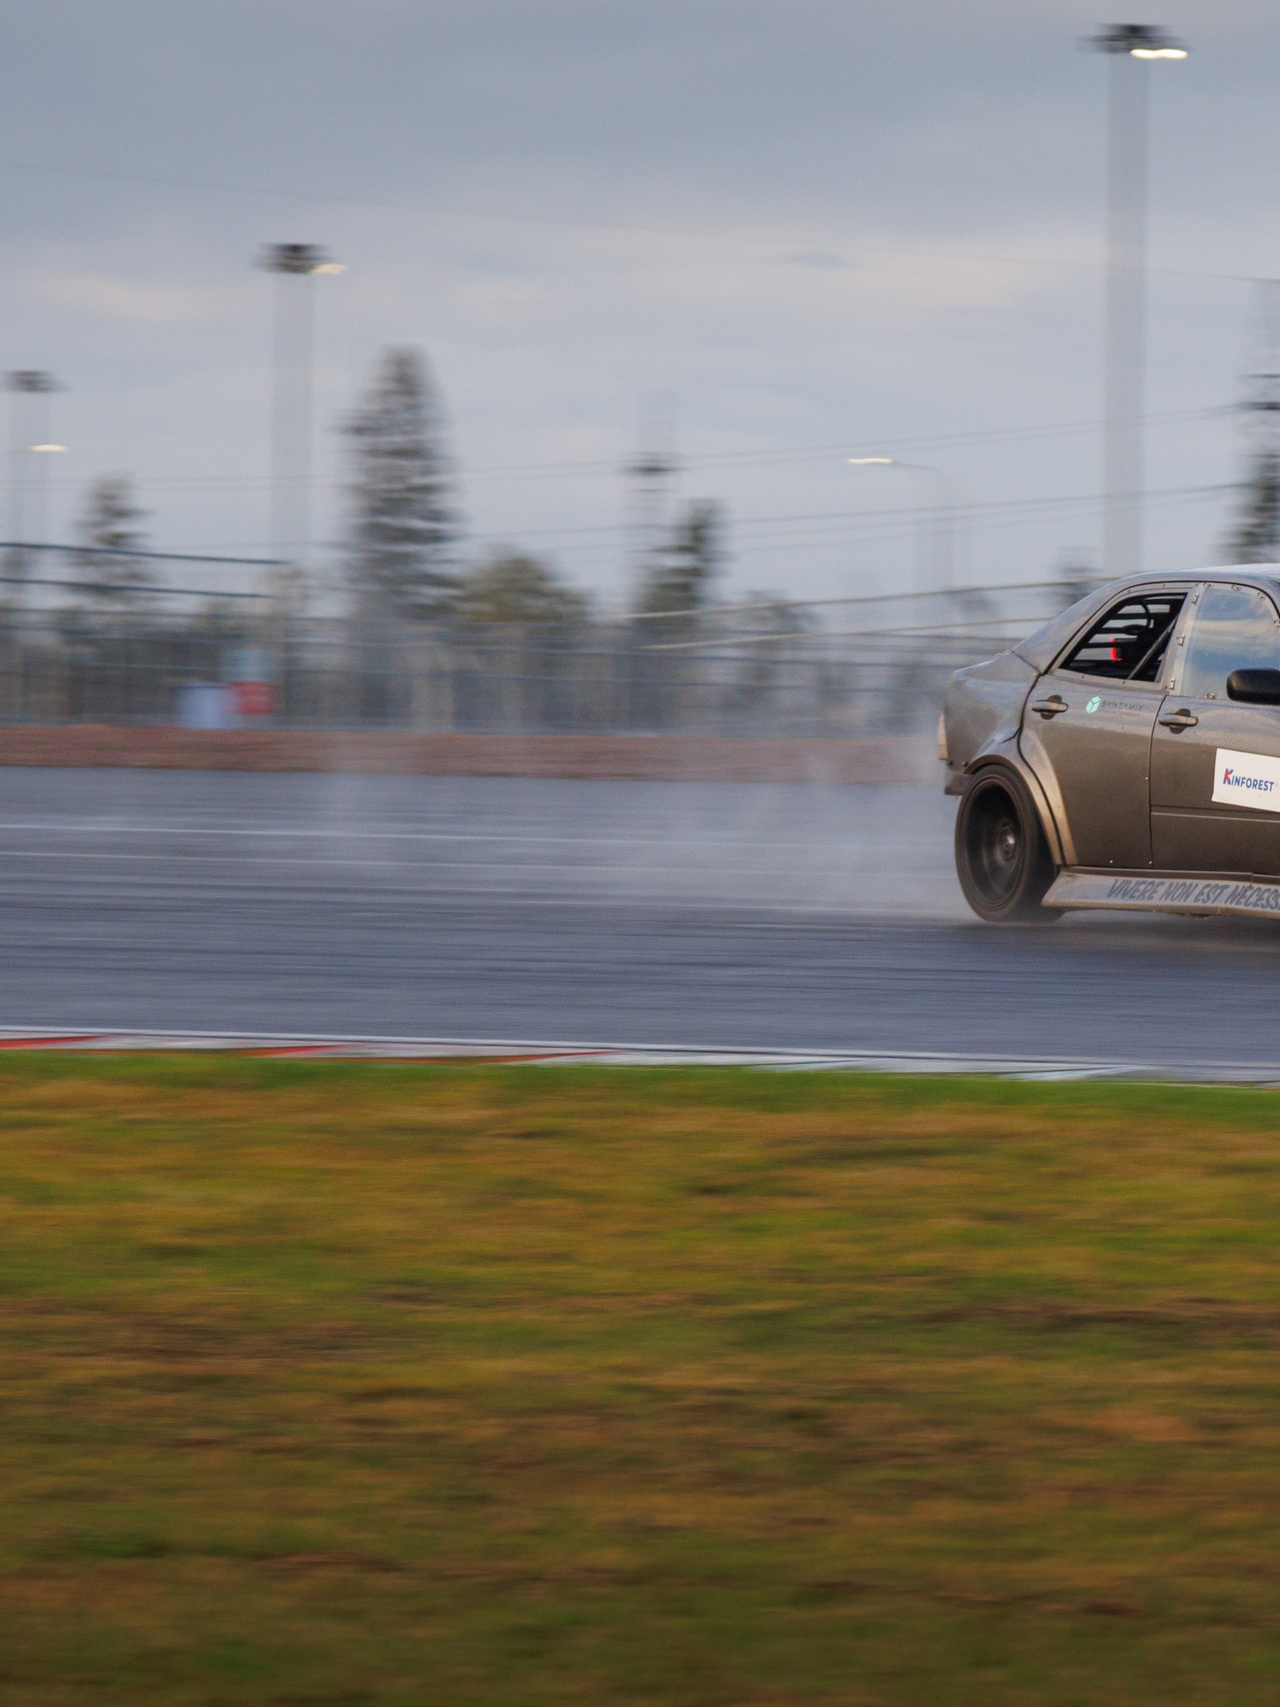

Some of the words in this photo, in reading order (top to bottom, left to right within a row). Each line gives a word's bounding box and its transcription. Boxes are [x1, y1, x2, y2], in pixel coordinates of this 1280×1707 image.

[1222, 768, 1275, 792] KINFOREST
[1106, 879, 1165, 900] VIVERE
[1159, 881, 1199, 902] NON
[1193, 883, 1230, 904] EST
